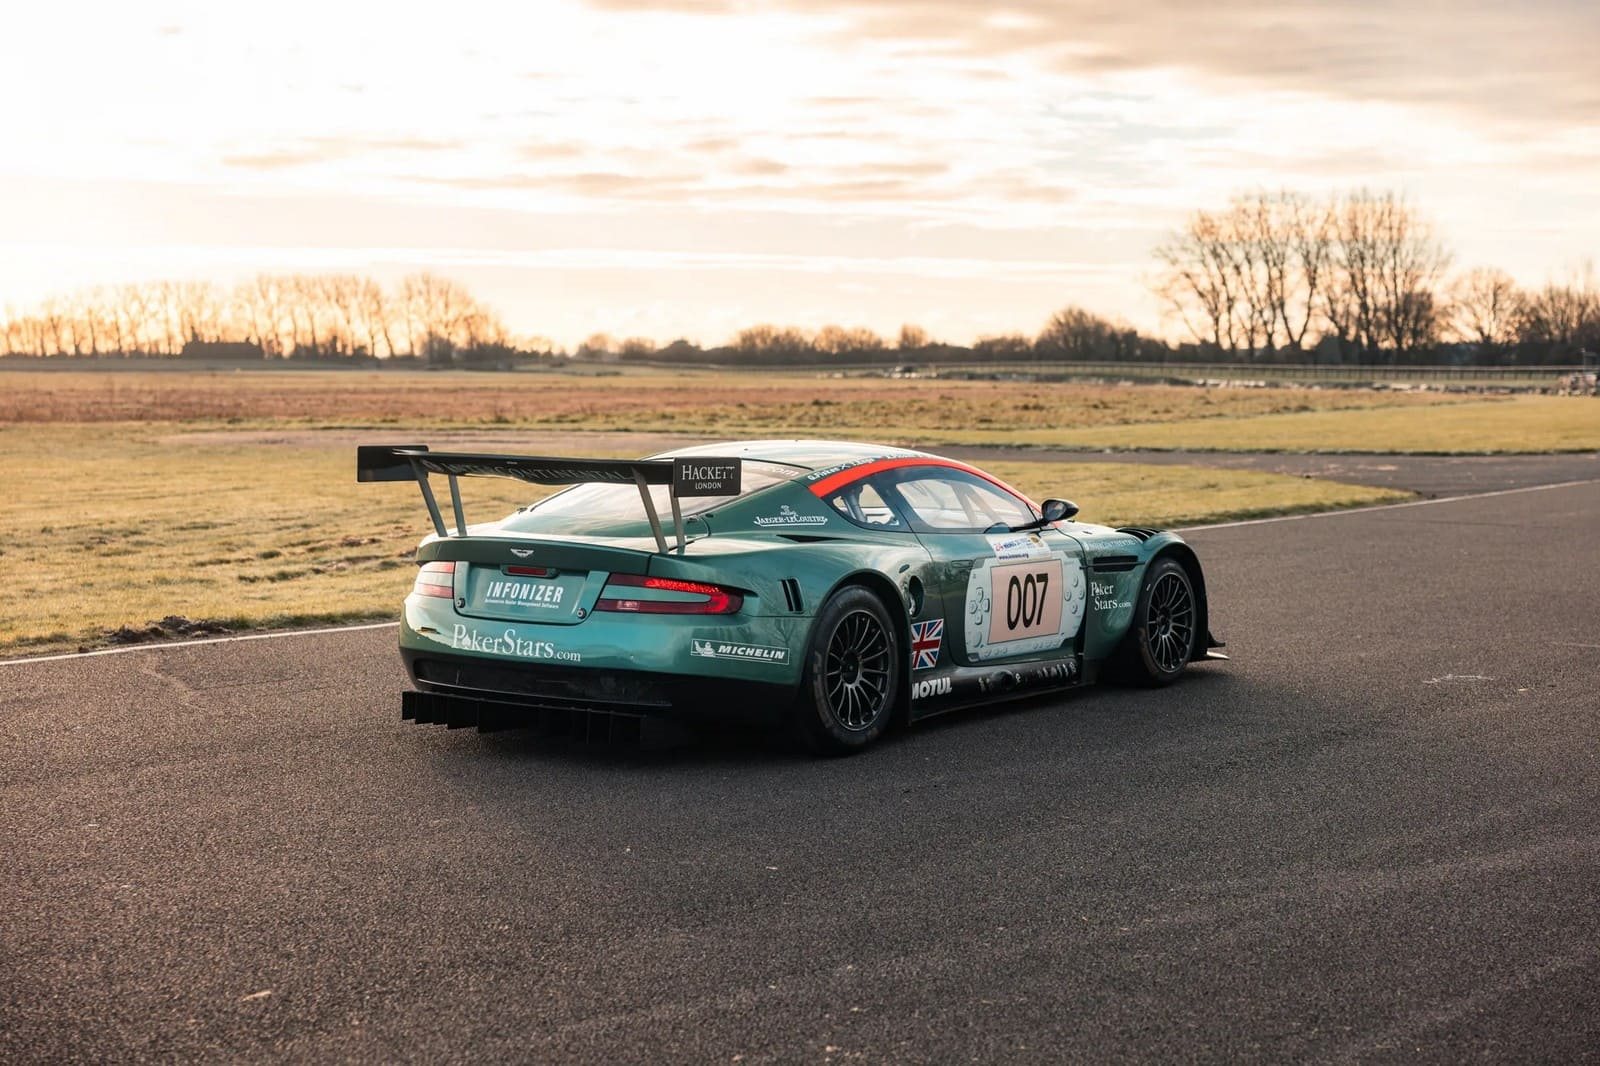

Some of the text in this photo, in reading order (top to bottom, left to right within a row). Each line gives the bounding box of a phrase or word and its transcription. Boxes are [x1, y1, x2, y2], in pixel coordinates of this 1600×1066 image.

[681, 464, 736, 480] HACKETT
[695, 482, 722, 490] LONDON
[486, 582, 564, 603] INFONIZER
[1007, 573, 1049, 631] 007
[718, 645, 785, 660] MICHELIN
